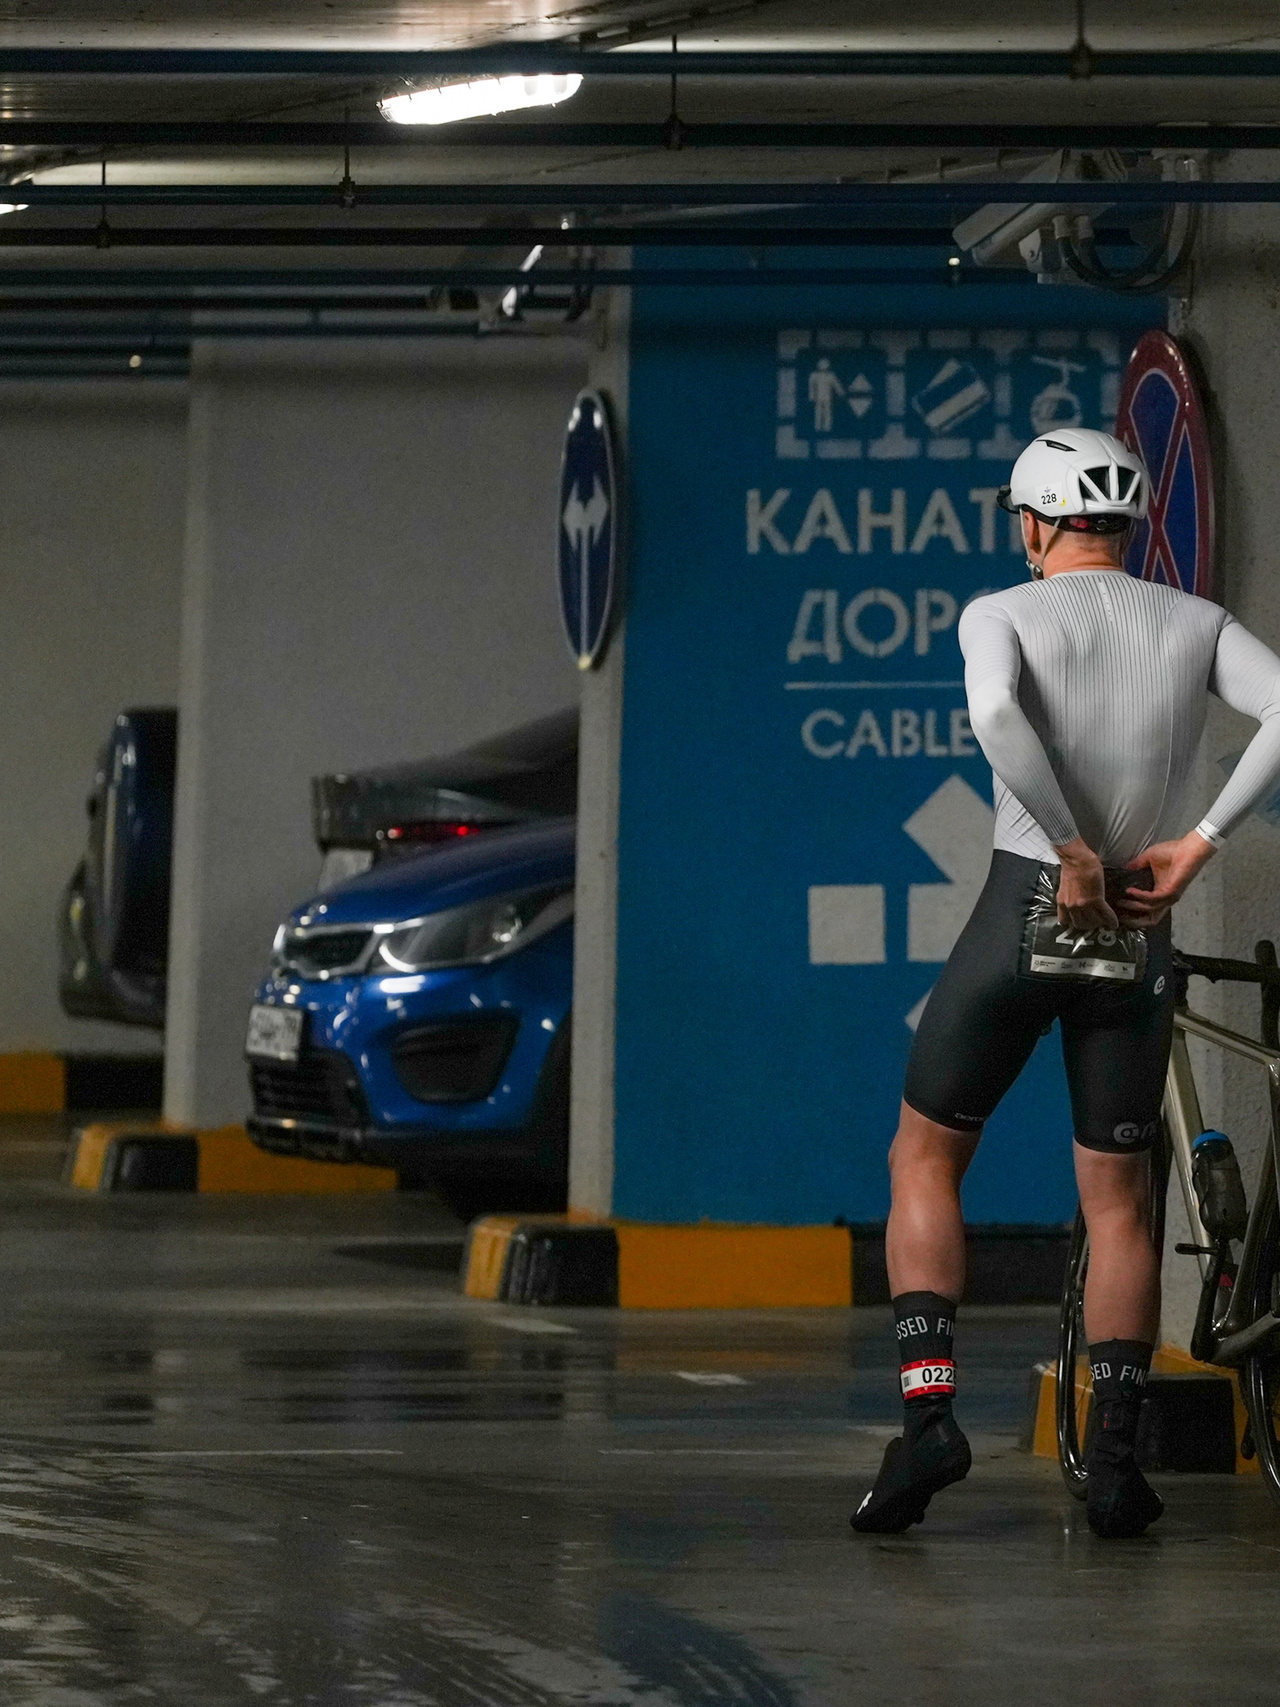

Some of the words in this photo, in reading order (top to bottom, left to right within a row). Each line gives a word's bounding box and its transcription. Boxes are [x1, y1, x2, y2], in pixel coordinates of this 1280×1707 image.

[1041, 493, 1057, 504] 228
[787, 586, 1000, 664] ДОР
[801, 708, 978, 758] CABLE
